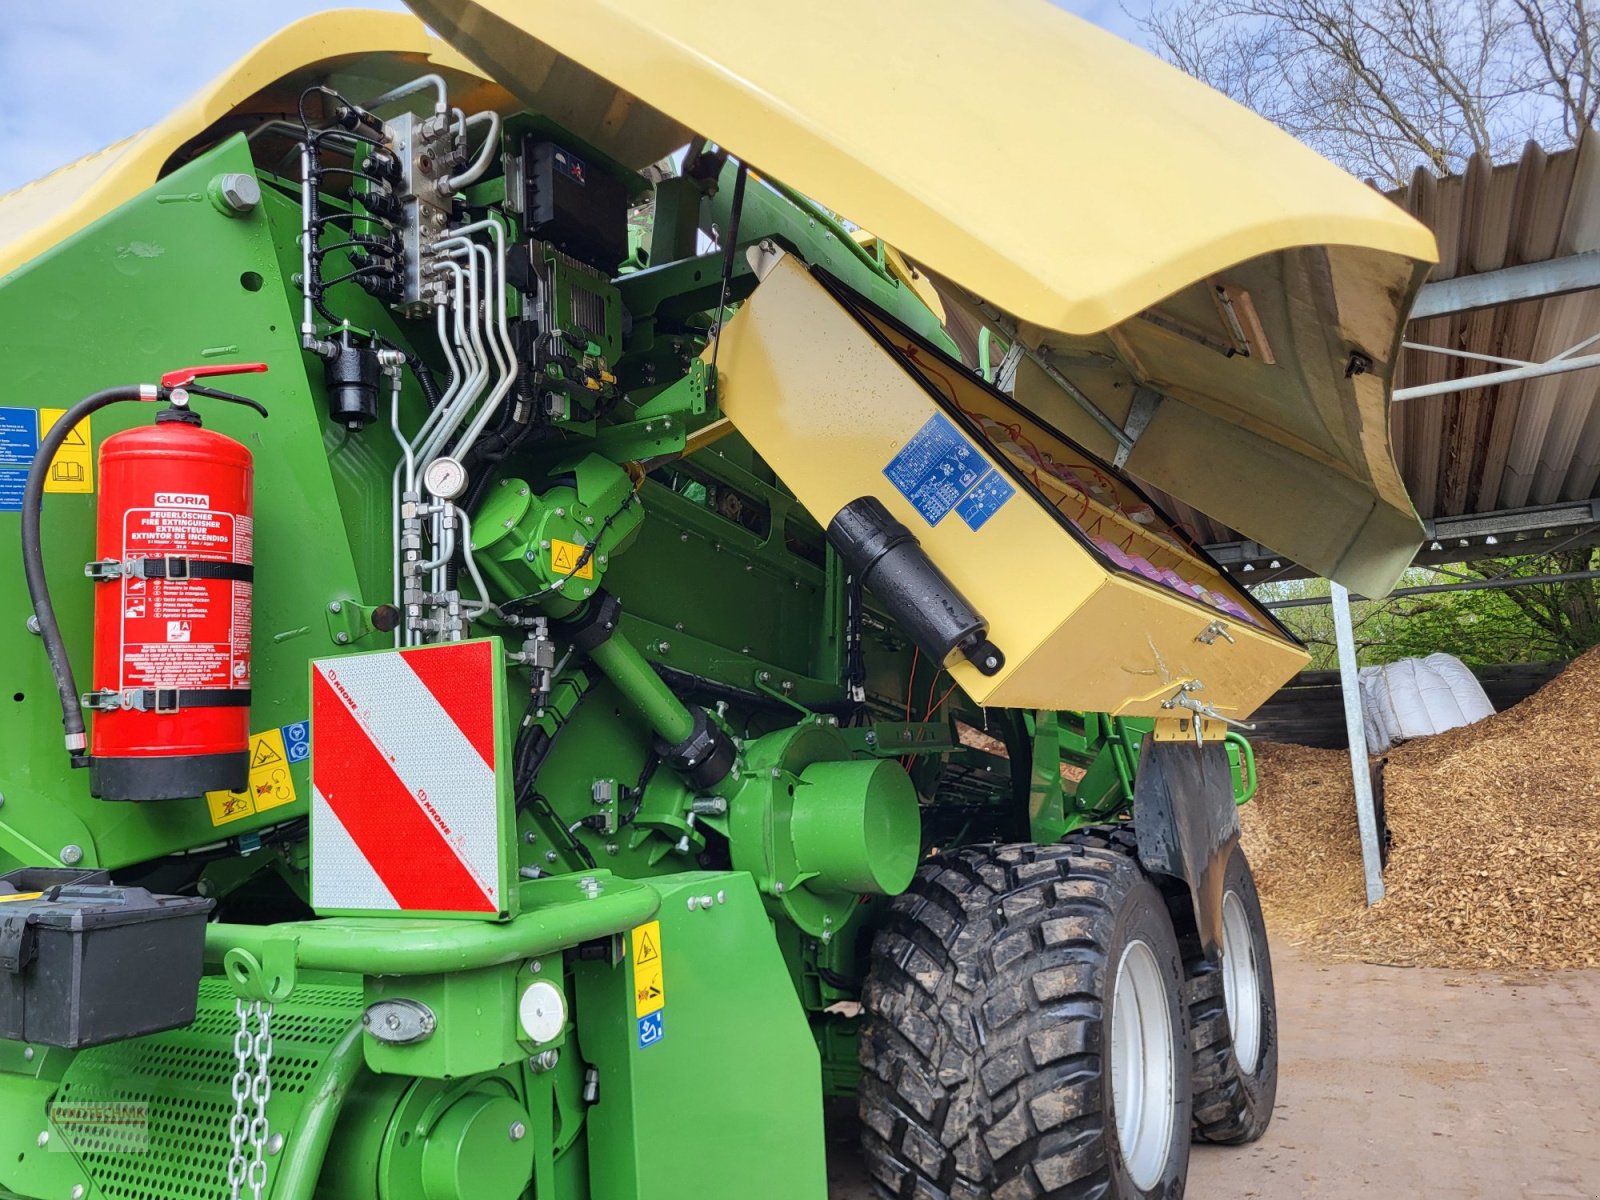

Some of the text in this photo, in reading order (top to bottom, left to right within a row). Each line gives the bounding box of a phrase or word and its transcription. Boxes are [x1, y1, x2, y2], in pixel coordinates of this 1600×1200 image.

[156, 495, 208, 506] GLORIA
[150, 511, 213, 521] FEUERLÖSCHER
[141, 518, 221, 528] FIRE EXTINGUISHER
[156, 525, 207, 534] EXTINCTEUR
[131, 532, 172, 540] EXTINTOR
[188, 533, 229, 543] INCENDIOS
[334, 681, 358, 710] KRONE
[424, 801, 451, 835] KRONE
